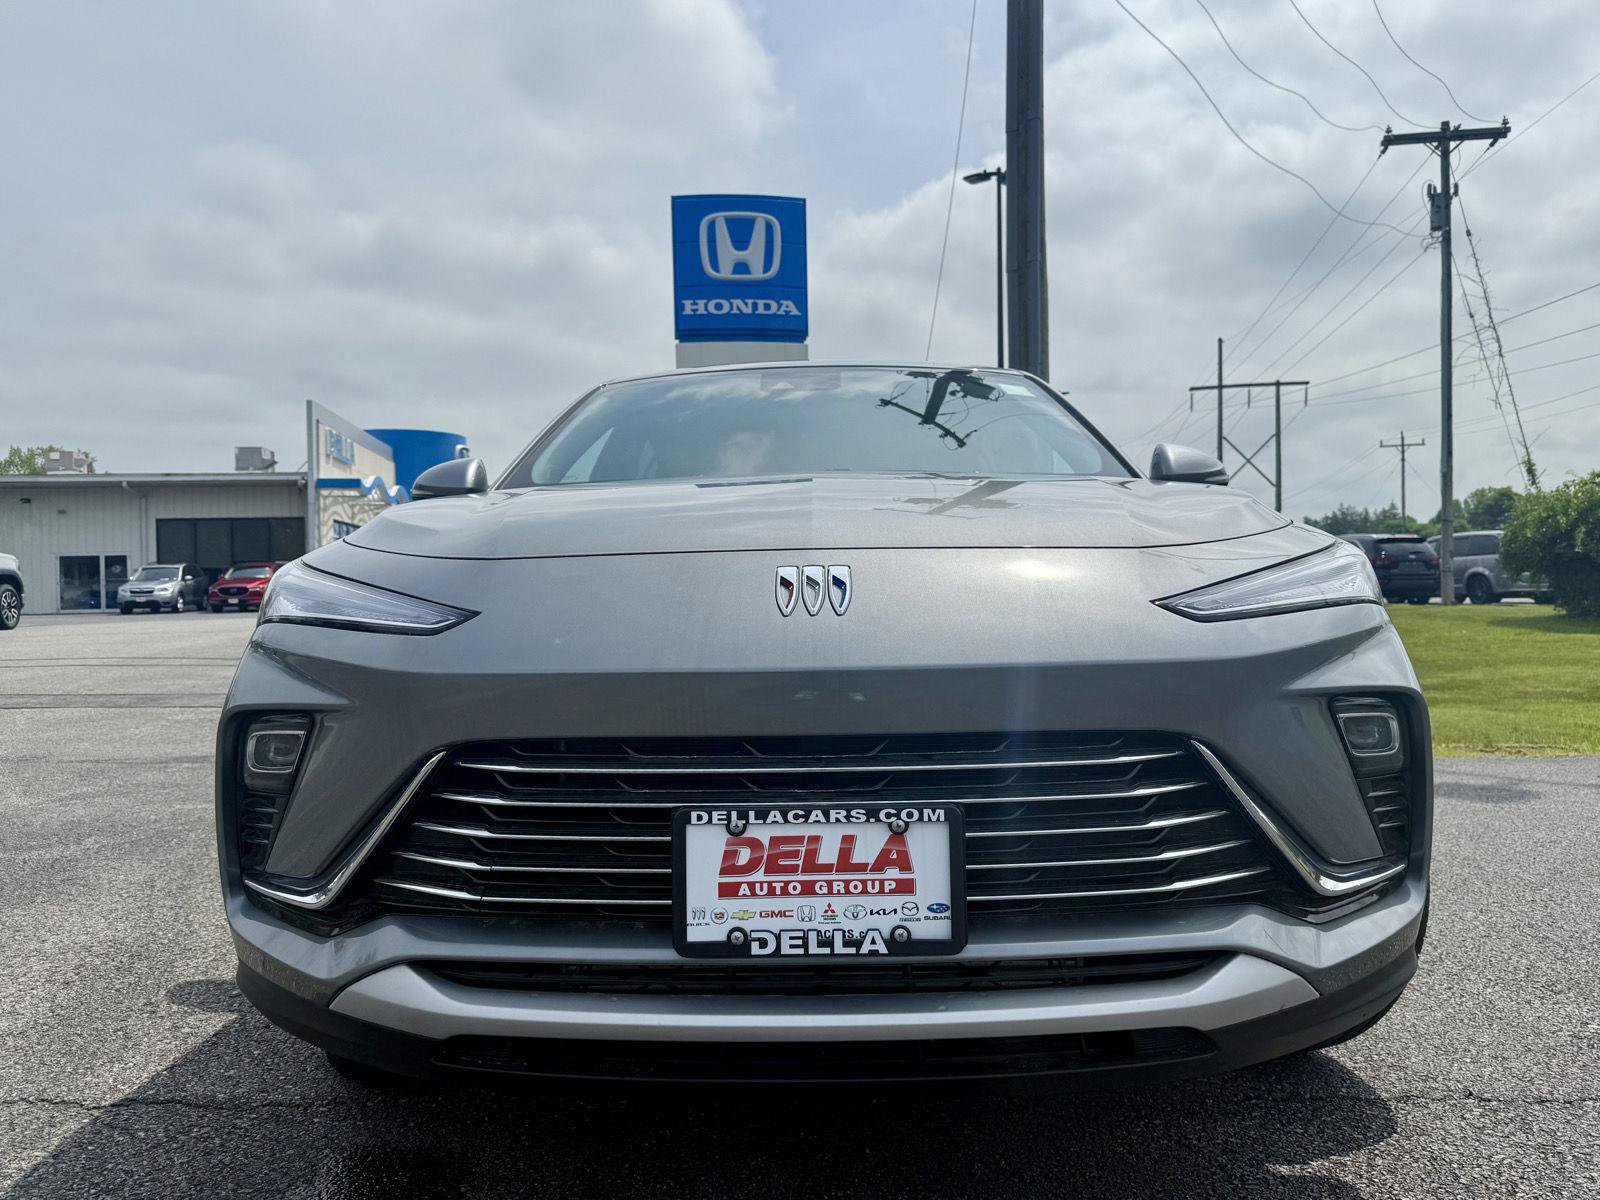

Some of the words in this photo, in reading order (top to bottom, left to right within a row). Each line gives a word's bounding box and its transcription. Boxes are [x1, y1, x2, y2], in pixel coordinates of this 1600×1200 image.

[682, 299, 802, 316] HONDA
[689, 808, 946, 825] DELLACARS.COM
[718, 834, 916, 878] DELLA
[737, 881, 802, 896] AUTO
[814, 879, 898, 895] GROUP
[758, 909, 795, 919] GMC
[869, 907, 898, 916] KIA
[751, 929, 889, 956] DELLA
